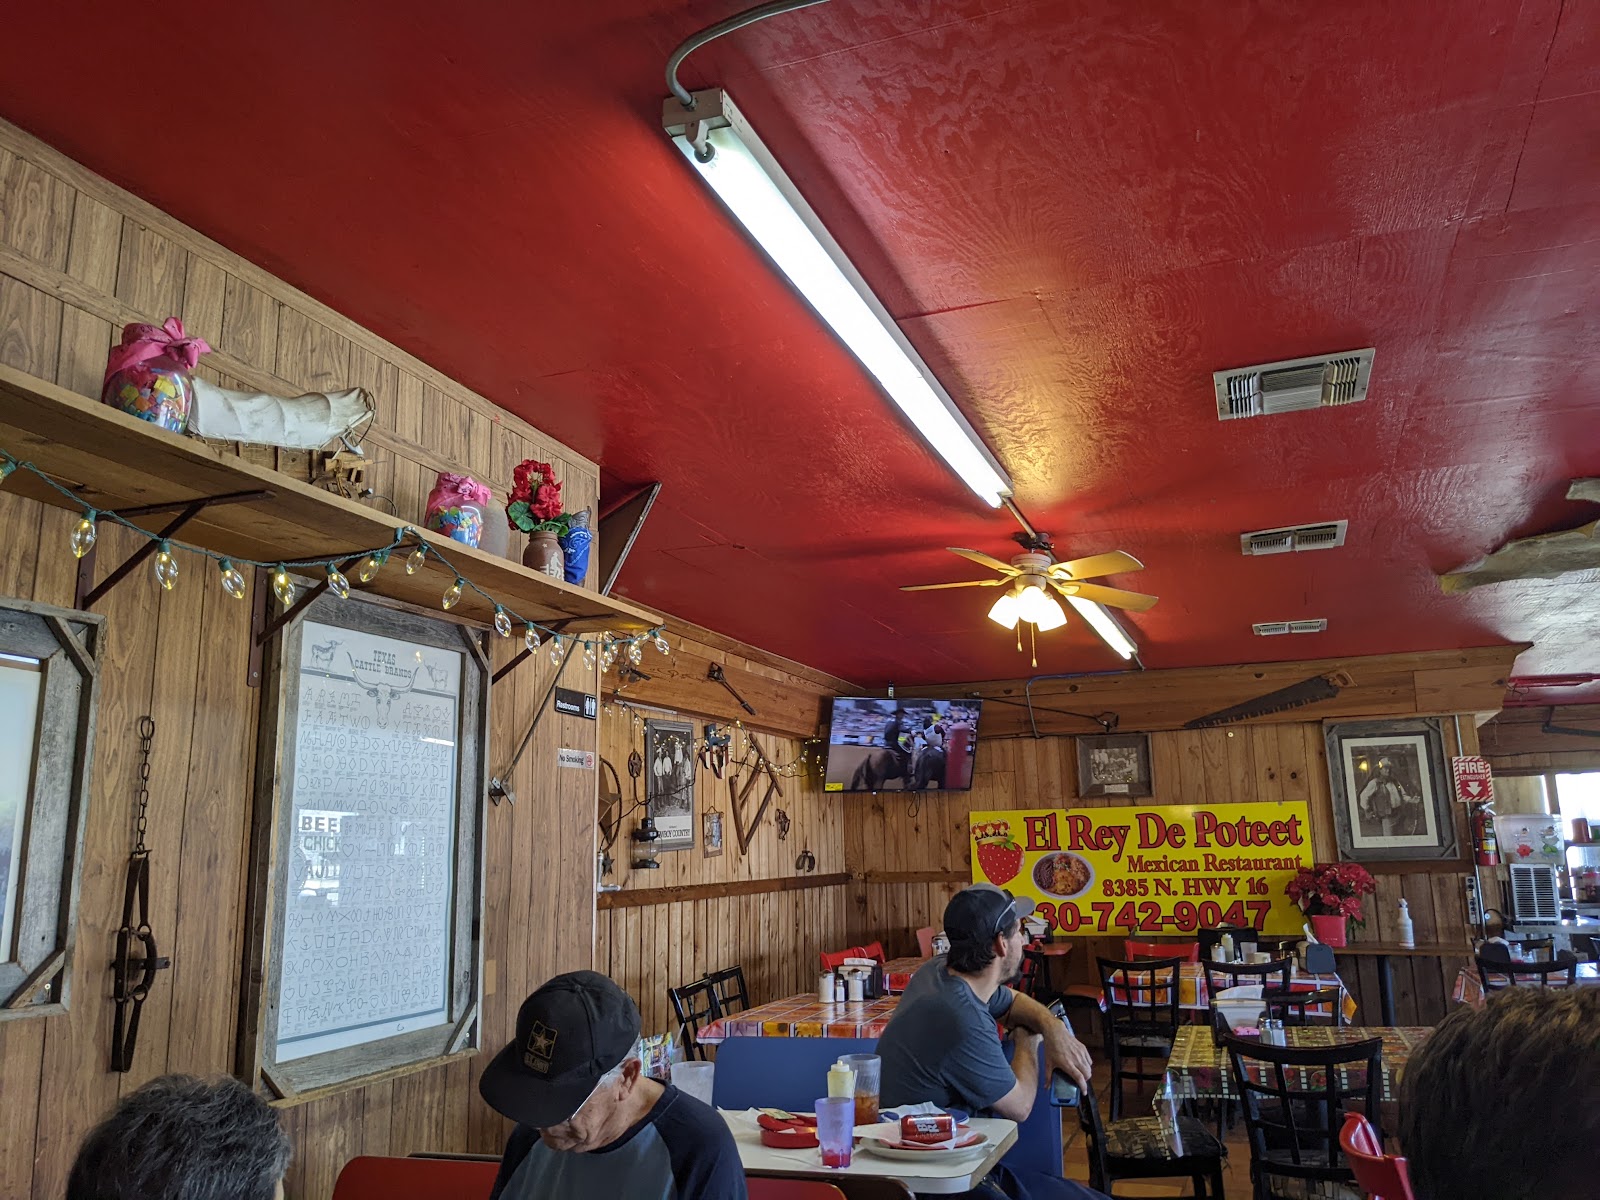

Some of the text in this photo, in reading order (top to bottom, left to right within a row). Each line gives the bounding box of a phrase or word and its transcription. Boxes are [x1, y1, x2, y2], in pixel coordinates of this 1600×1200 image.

[373, 650, 396, 665] TEXAS
[355, 660, 412, 679] CATTLE BRANDS
[556, 700, 580, 712] Restrooms
[559, 754, 585, 766] No Smoking
[1458, 761, 1486, 774] FIRE
[1459, 773, 1486, 781] EXTINGUISHER
[1024, 810, 1304, 863] El Rey De Poteet
[1127, 853, 1303, 873] Mexican Restaurant
[1102, 876, 1269, 897] 8385 N. HWY 16
[1020, 900, 1271, 932] 30-742-9047
